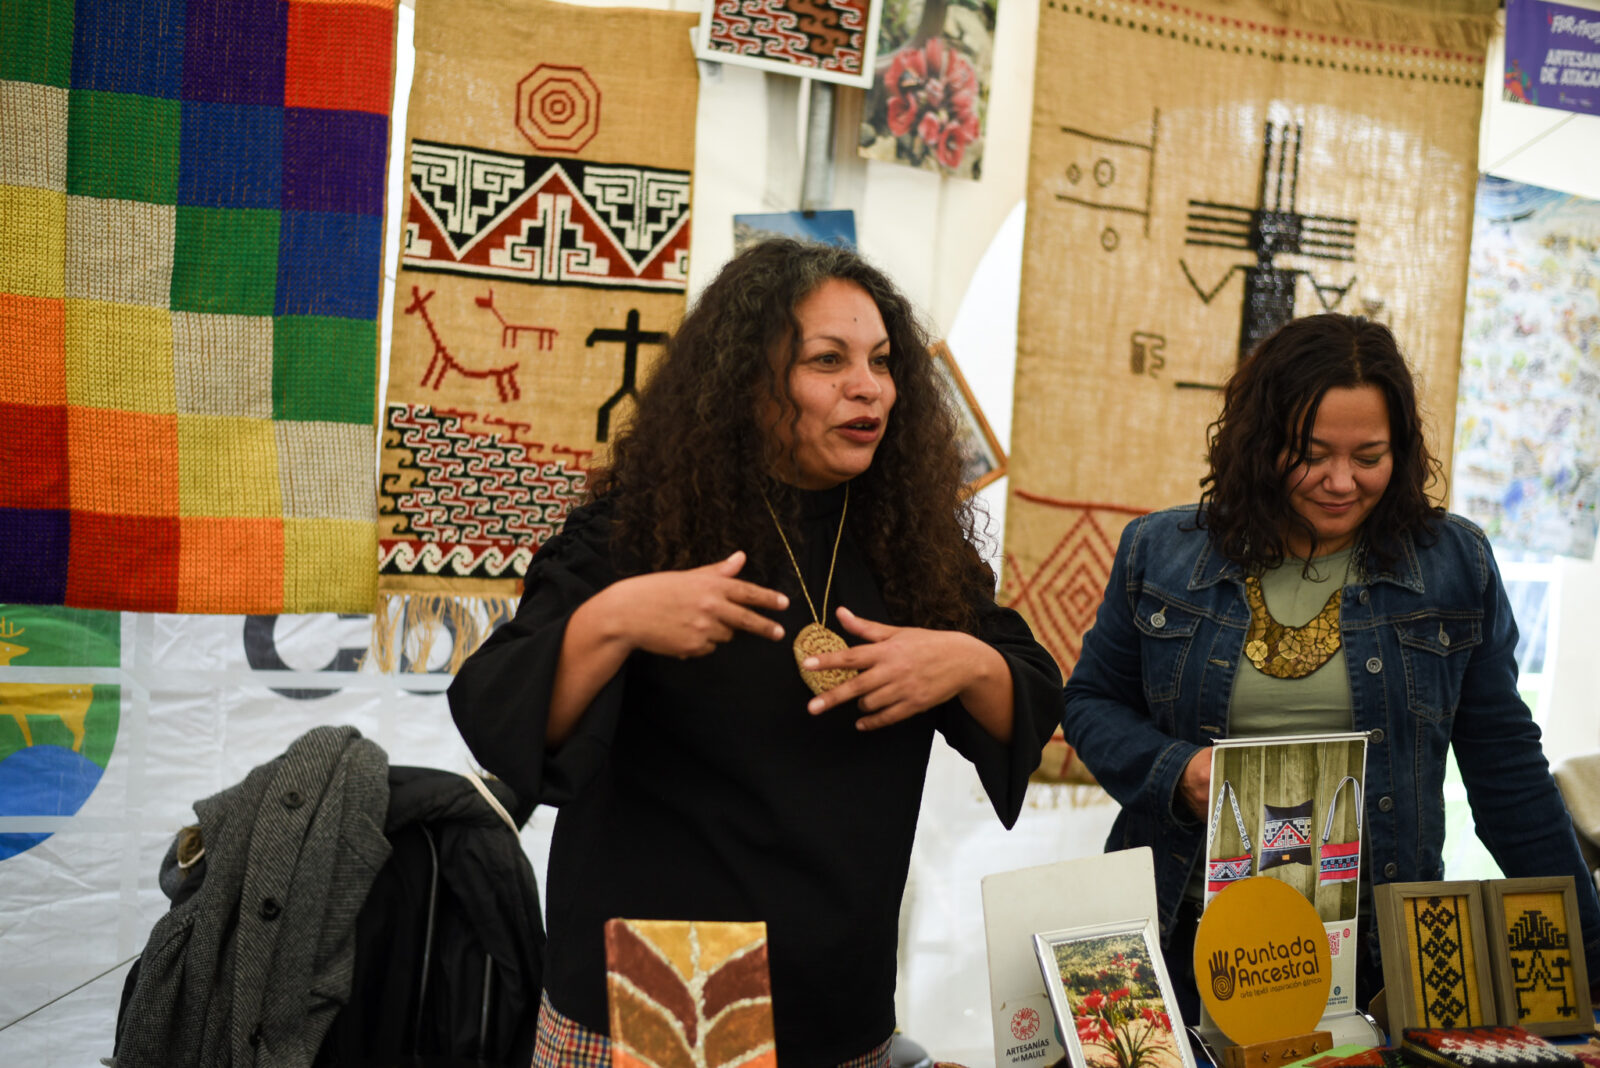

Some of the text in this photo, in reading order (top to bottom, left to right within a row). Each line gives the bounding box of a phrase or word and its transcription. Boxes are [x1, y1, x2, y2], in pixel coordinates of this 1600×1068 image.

[1540, 66, 1559, 85] DE
[1234, 935, 1316, 968] Puntada
[1238, 953, 1319, 988] Ancestral
[1006, 1039, 1049, 1056] ARTESANÍAS
[1020, 1049, 1046, 1061] MAULE
